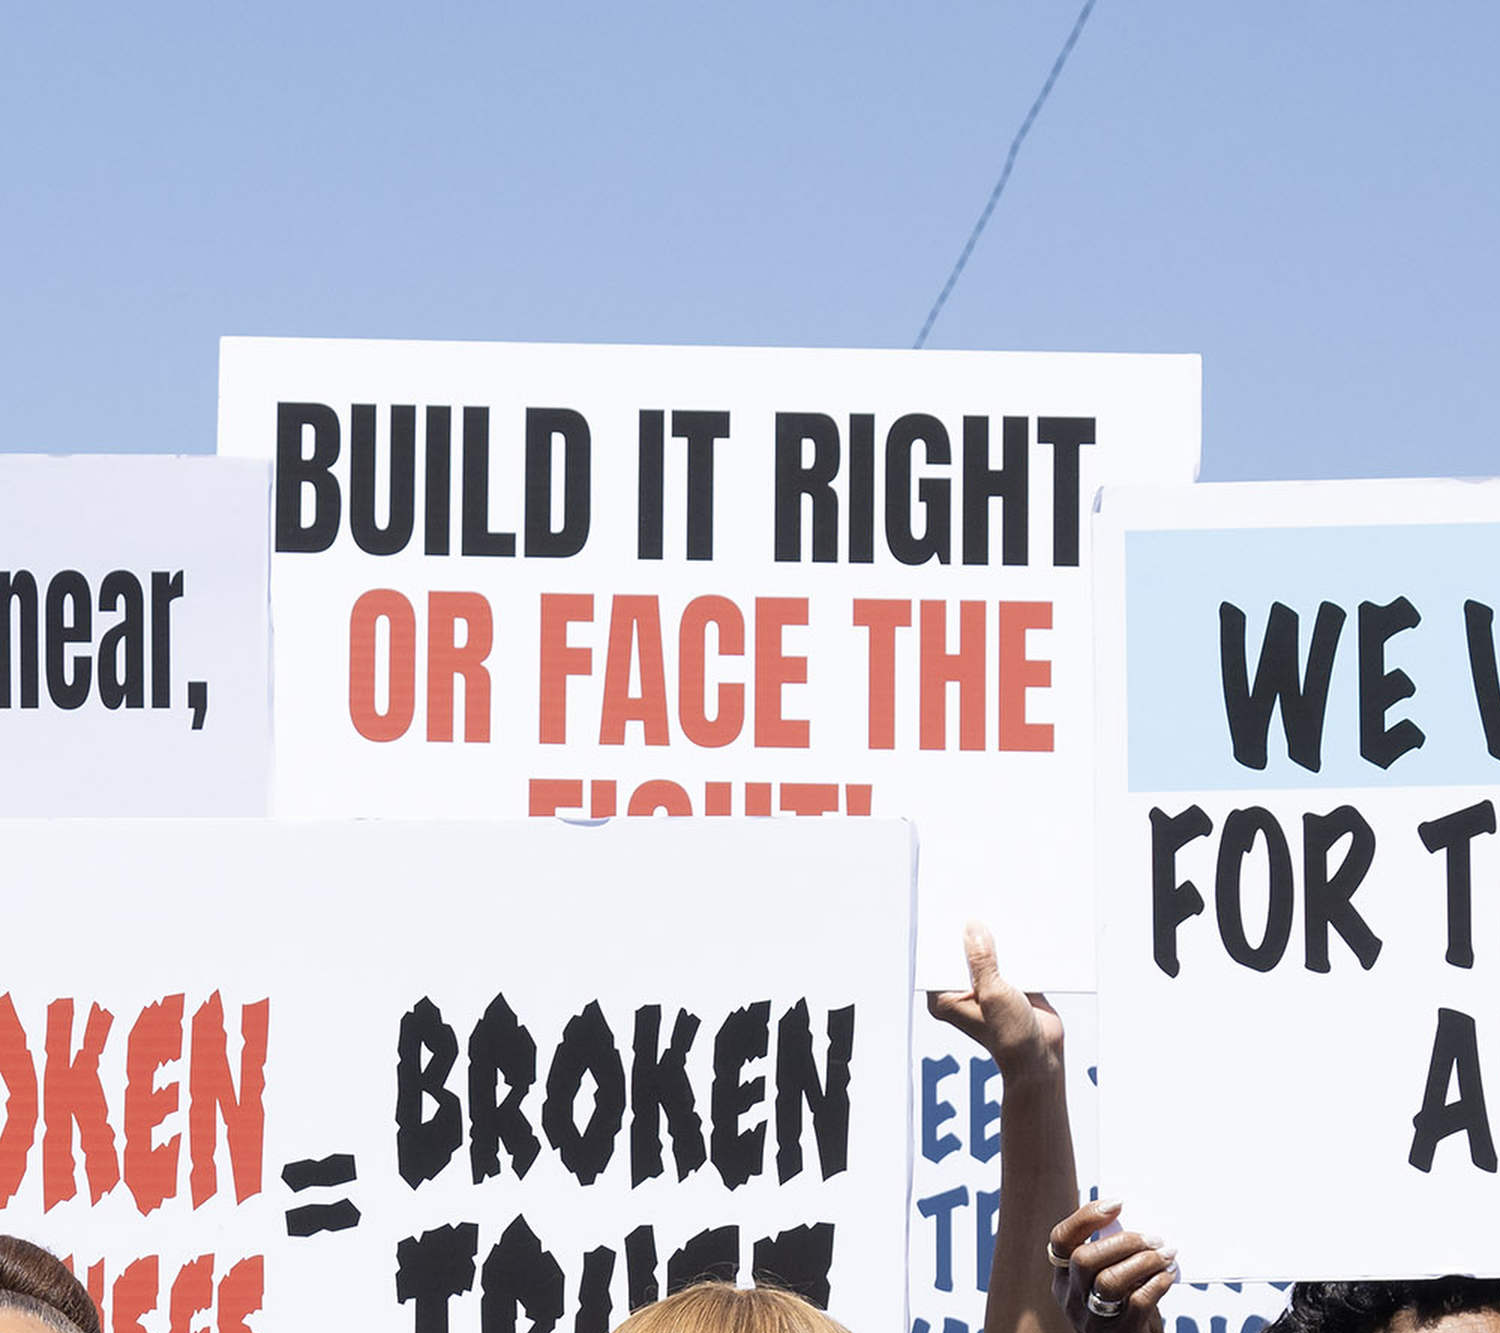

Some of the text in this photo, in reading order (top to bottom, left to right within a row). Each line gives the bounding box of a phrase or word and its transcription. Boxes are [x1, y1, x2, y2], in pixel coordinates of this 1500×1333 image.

[275, 402, 1096, 567] BUILD IT RIGHT
[350, 589, 1054, 752] OR FACE THE
[1219, 596, 1425, 773] WE
[1149, 805, 1382, 978] FOR
[395, 992, 855, 1191] BROKEN
